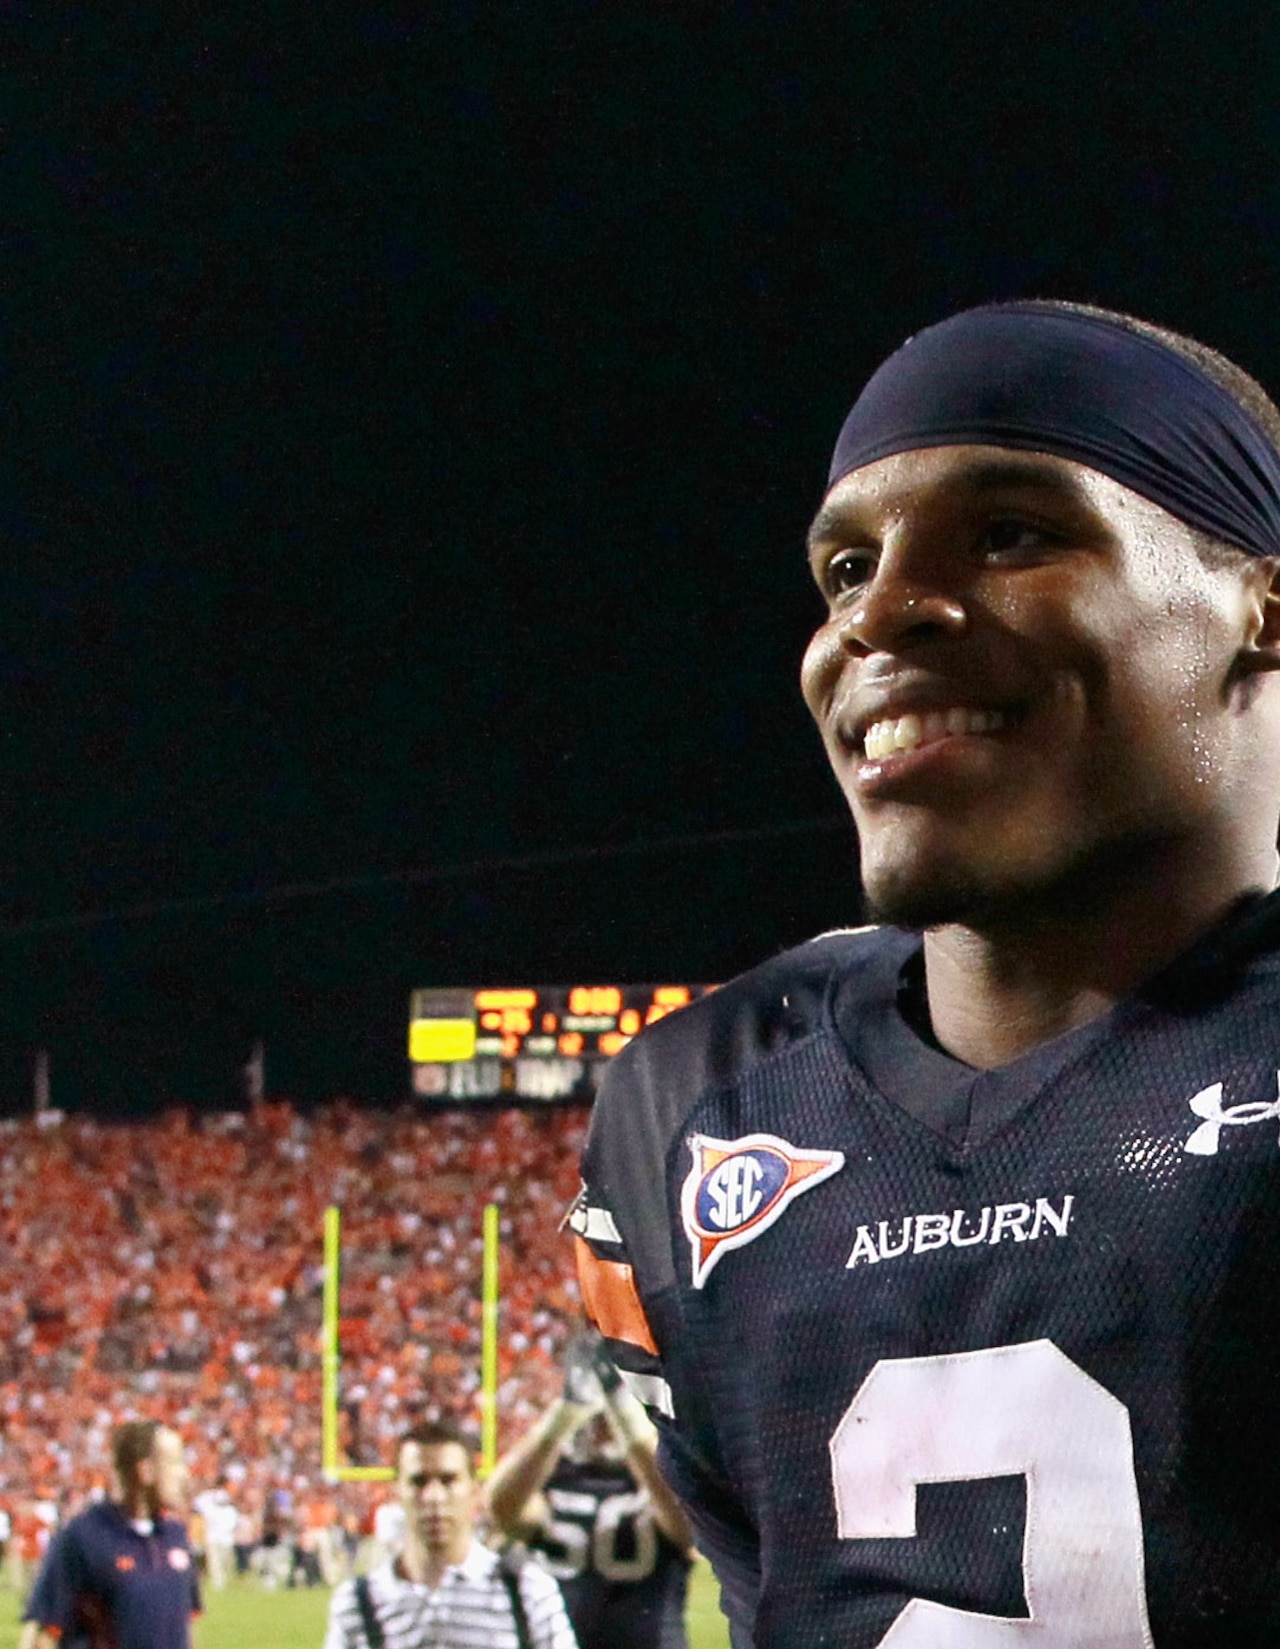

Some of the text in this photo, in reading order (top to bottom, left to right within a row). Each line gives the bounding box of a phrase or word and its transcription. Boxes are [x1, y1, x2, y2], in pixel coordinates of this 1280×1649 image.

[706, 1155, 765, 1229] SEC
[845, 1195, 1075, 1269] AUBURN
[536, 1488, 656, 1581] 50
